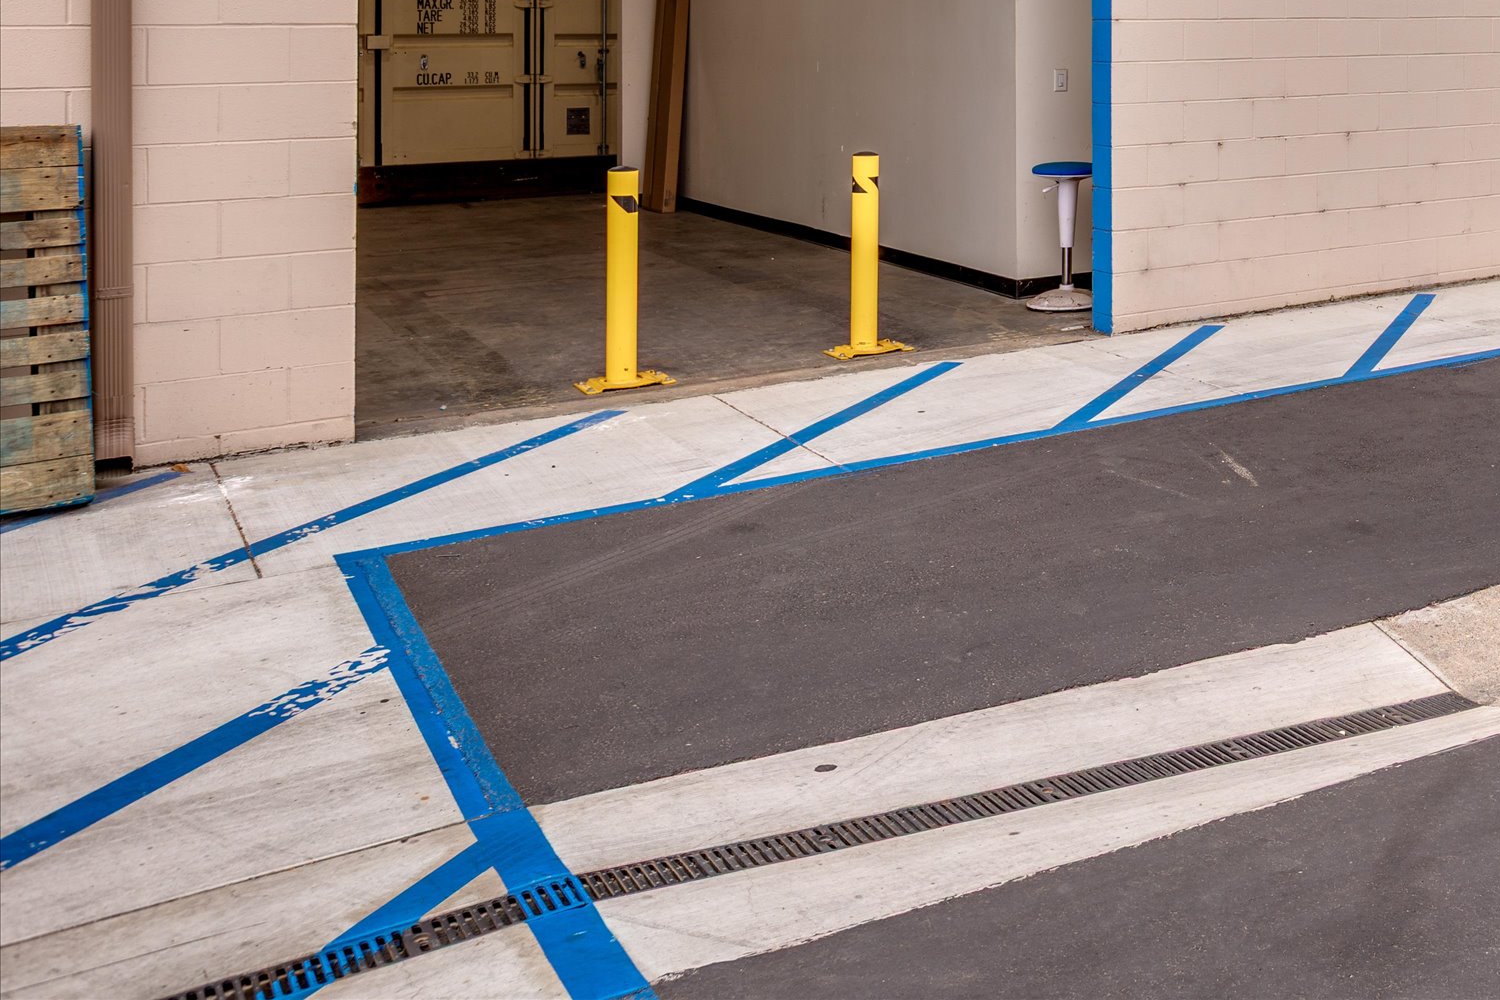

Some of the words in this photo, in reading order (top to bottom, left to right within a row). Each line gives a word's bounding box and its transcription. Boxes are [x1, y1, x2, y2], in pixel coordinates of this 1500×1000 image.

[417, 10, 443, 22] TARE
[416, 22, 436, 34] NET
[416, 72, 453, 86] CU.CAP.
